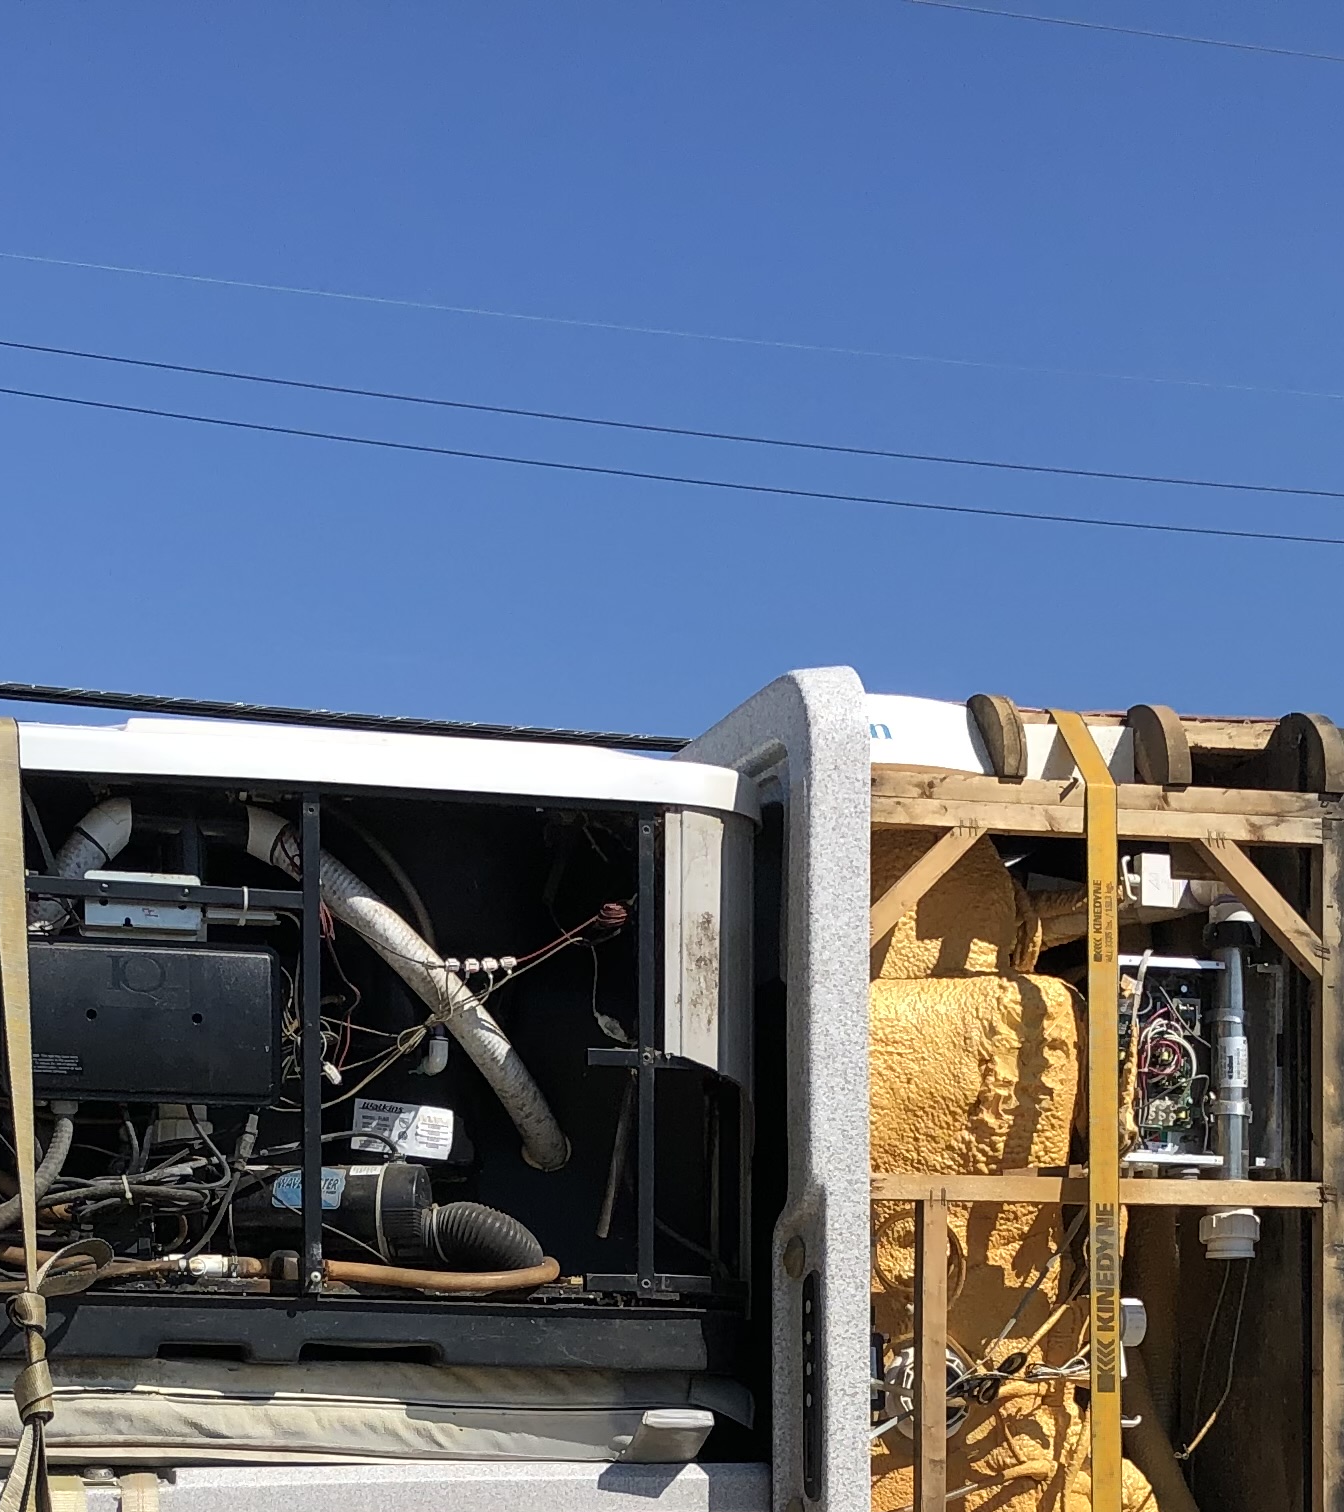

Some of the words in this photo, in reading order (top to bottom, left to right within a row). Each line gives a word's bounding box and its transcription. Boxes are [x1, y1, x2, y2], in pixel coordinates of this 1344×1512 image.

[1093, 880, 1102, 934] KINEDYNE
[360, 1101, 405, 1114] Watkins
[277, 1177, 340, 1191] WAVTER
[1095, 1202, 1115, 1333] KINEDYNE
